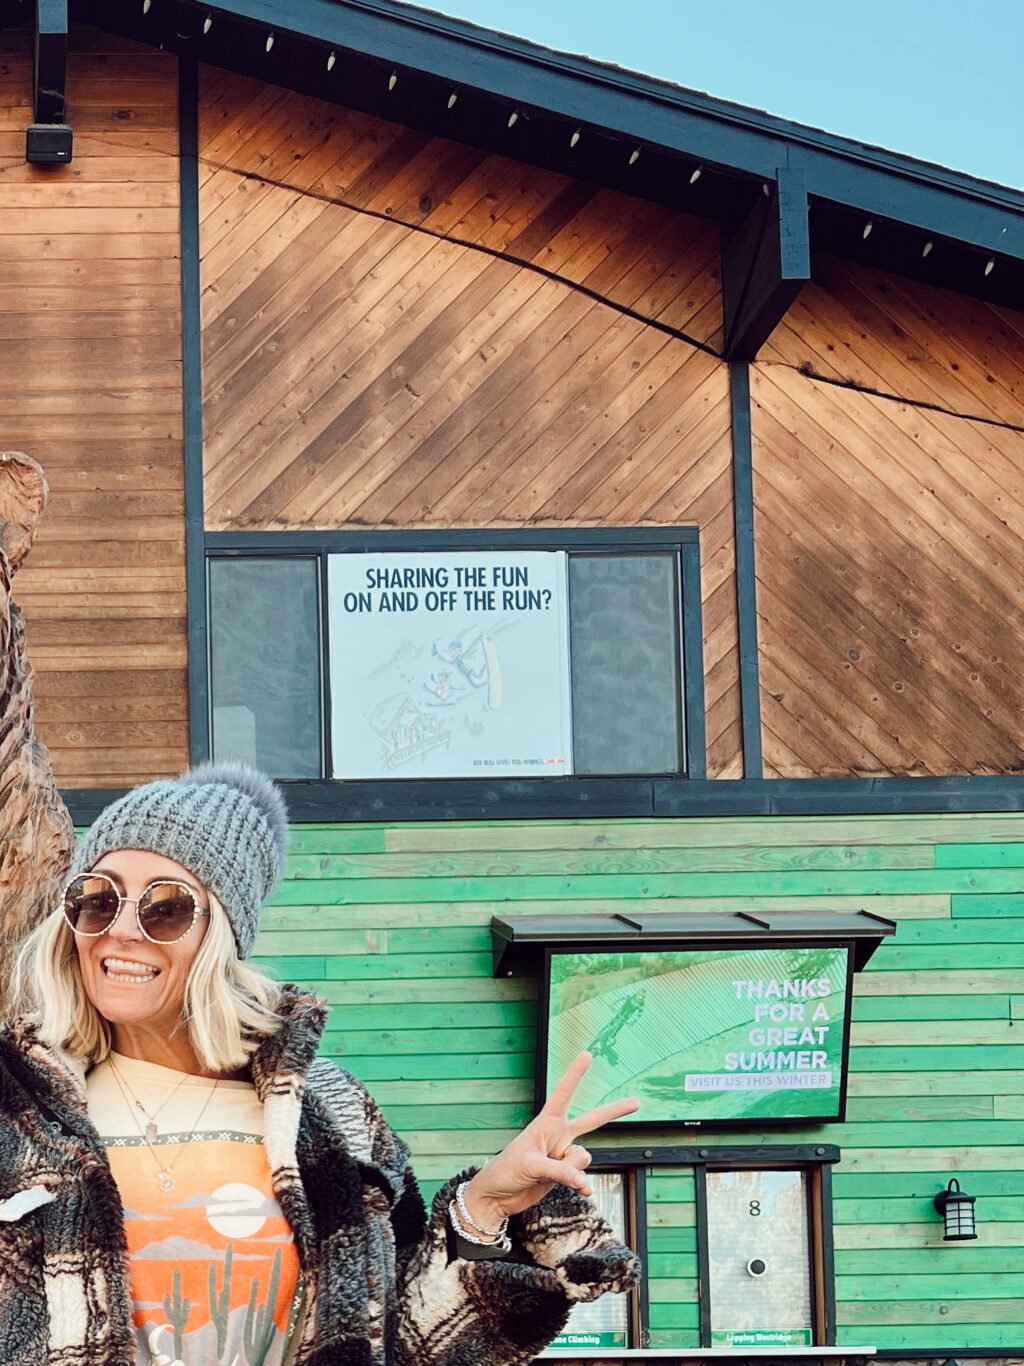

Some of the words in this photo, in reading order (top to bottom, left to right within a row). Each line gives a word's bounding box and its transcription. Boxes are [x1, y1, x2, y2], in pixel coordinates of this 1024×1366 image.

[366, 567, 449, 589] SHARING
[454, 567, 486, 588] THE
[493, 566, 528, 587] FUN
[343, 592, 372, 613] ON
[378, 591, 419, 613] AND
[425, 590, 457, 612] OFF
[463, 590, 496, 611] THE
[503, 589, 552, 611] RUN?
[731, 978, 832, 999] THANKS
[754, 1002, 805, 1023] FOR
[812, 1002, 830, 1022] A
[748, 1026, 829, 1046] GREAT
[724, 1050, 828, 1071] SUMMER
[690, 1076, 723, 1088] VISIT
[726, 1076, 742, 1087] US
[746, 1075, 773, 1086] THIS
[776, 1074, 827, 1086] WINTER
[749, 1200, 761, 1216] 8
[568, 1335, 600, 1345] Climbing
